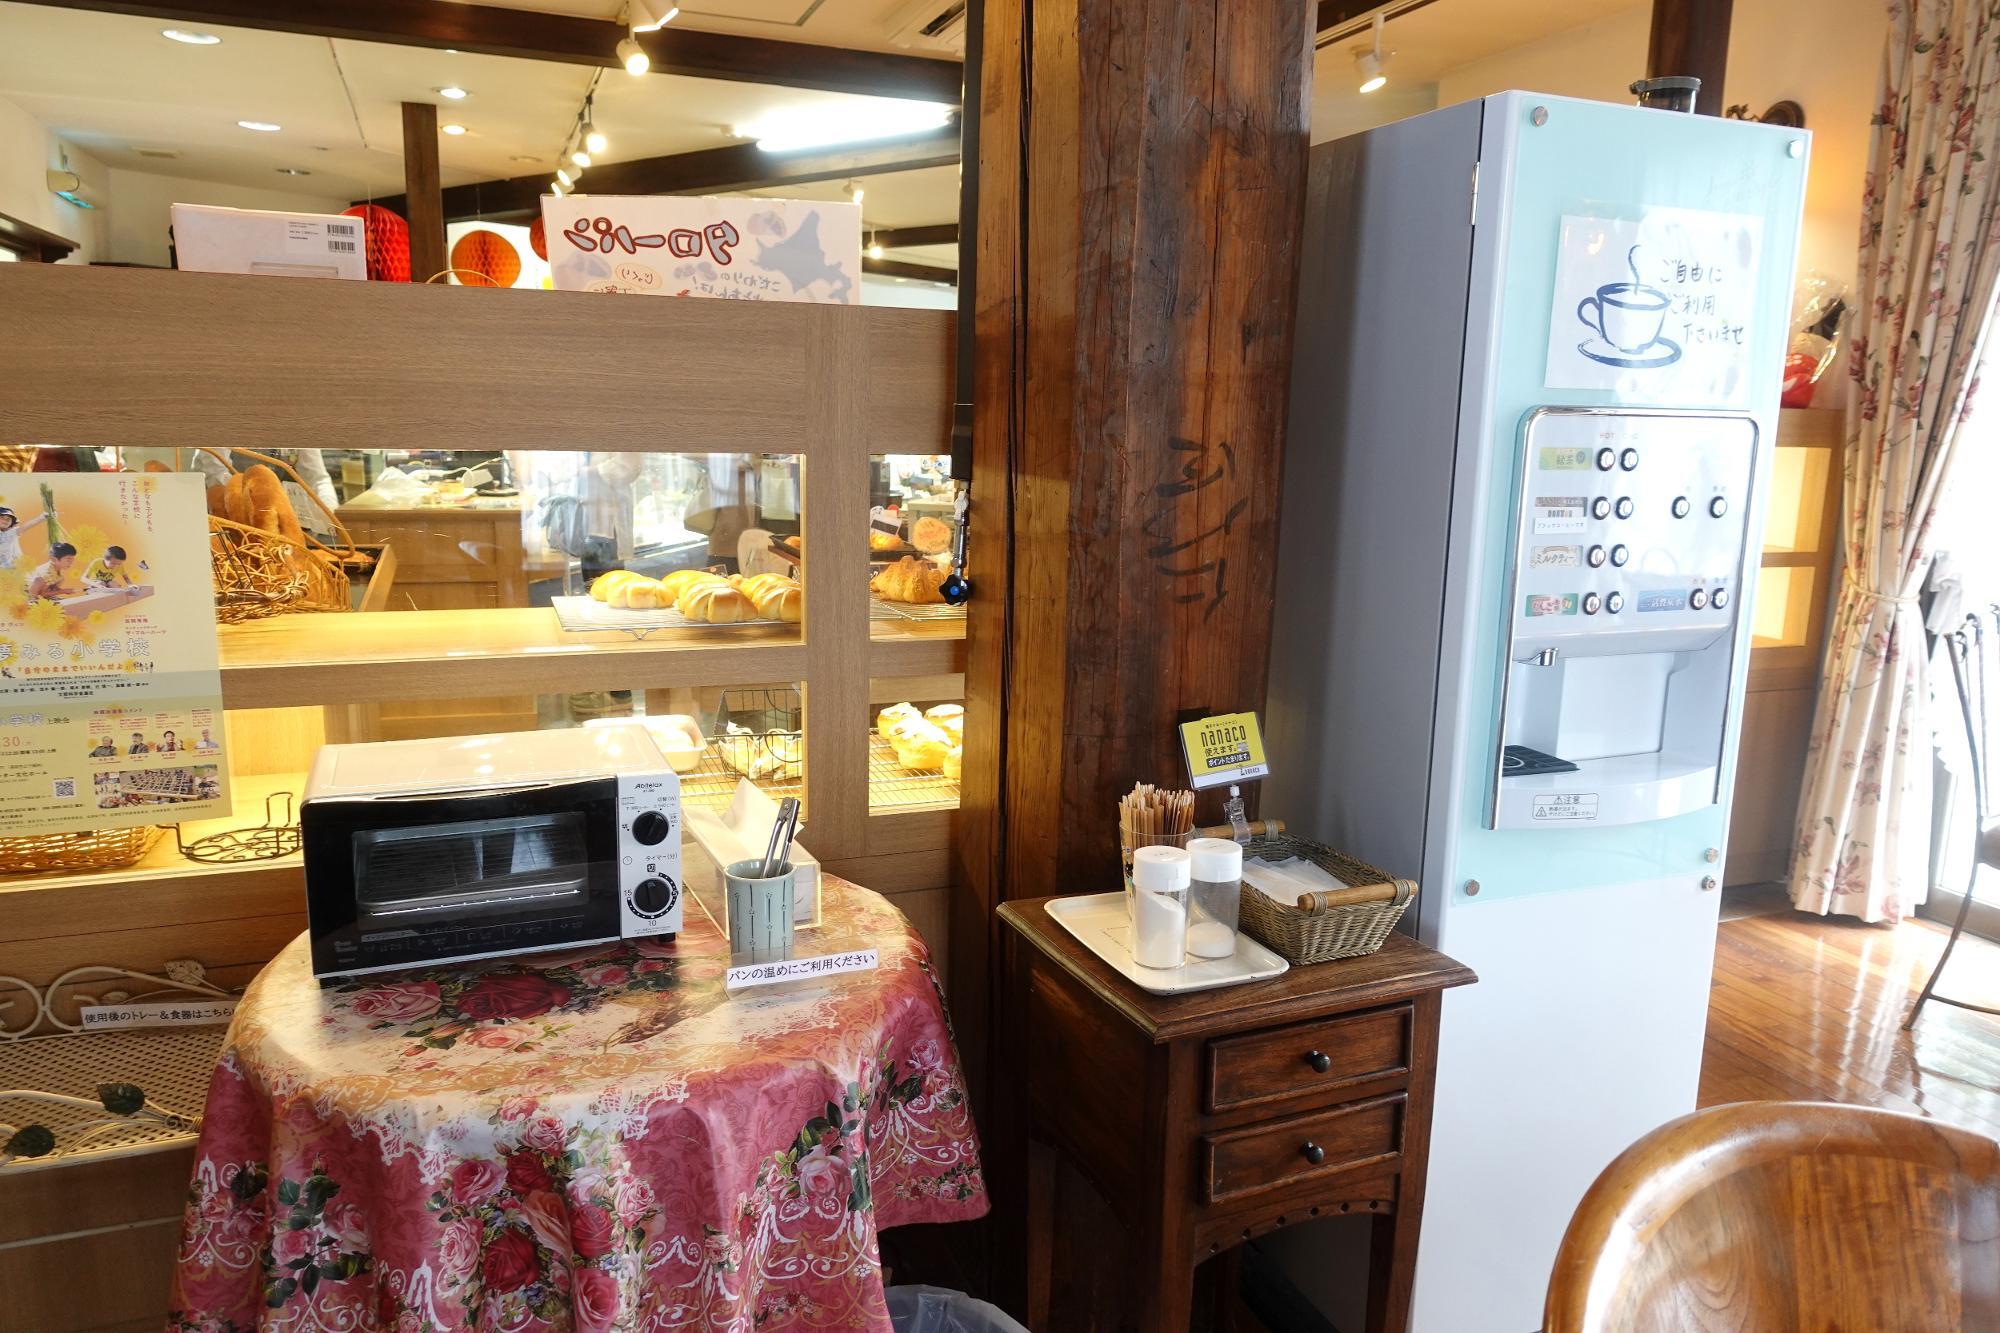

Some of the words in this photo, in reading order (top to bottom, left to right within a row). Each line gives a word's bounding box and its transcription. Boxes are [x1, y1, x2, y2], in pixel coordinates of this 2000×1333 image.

[1660, 259, 1722, 284] ご自由に
[1671, 293, 1716, 316] ご利用
[1683, 322, 1744, 345] 下さいませ
[3, 736, 21, 747] 30
[1200, 725, 1247, 748] nanaco
[623, 889, 633, 897] 15
[729, 955, 875, 981] パンの温めにご利用ください
